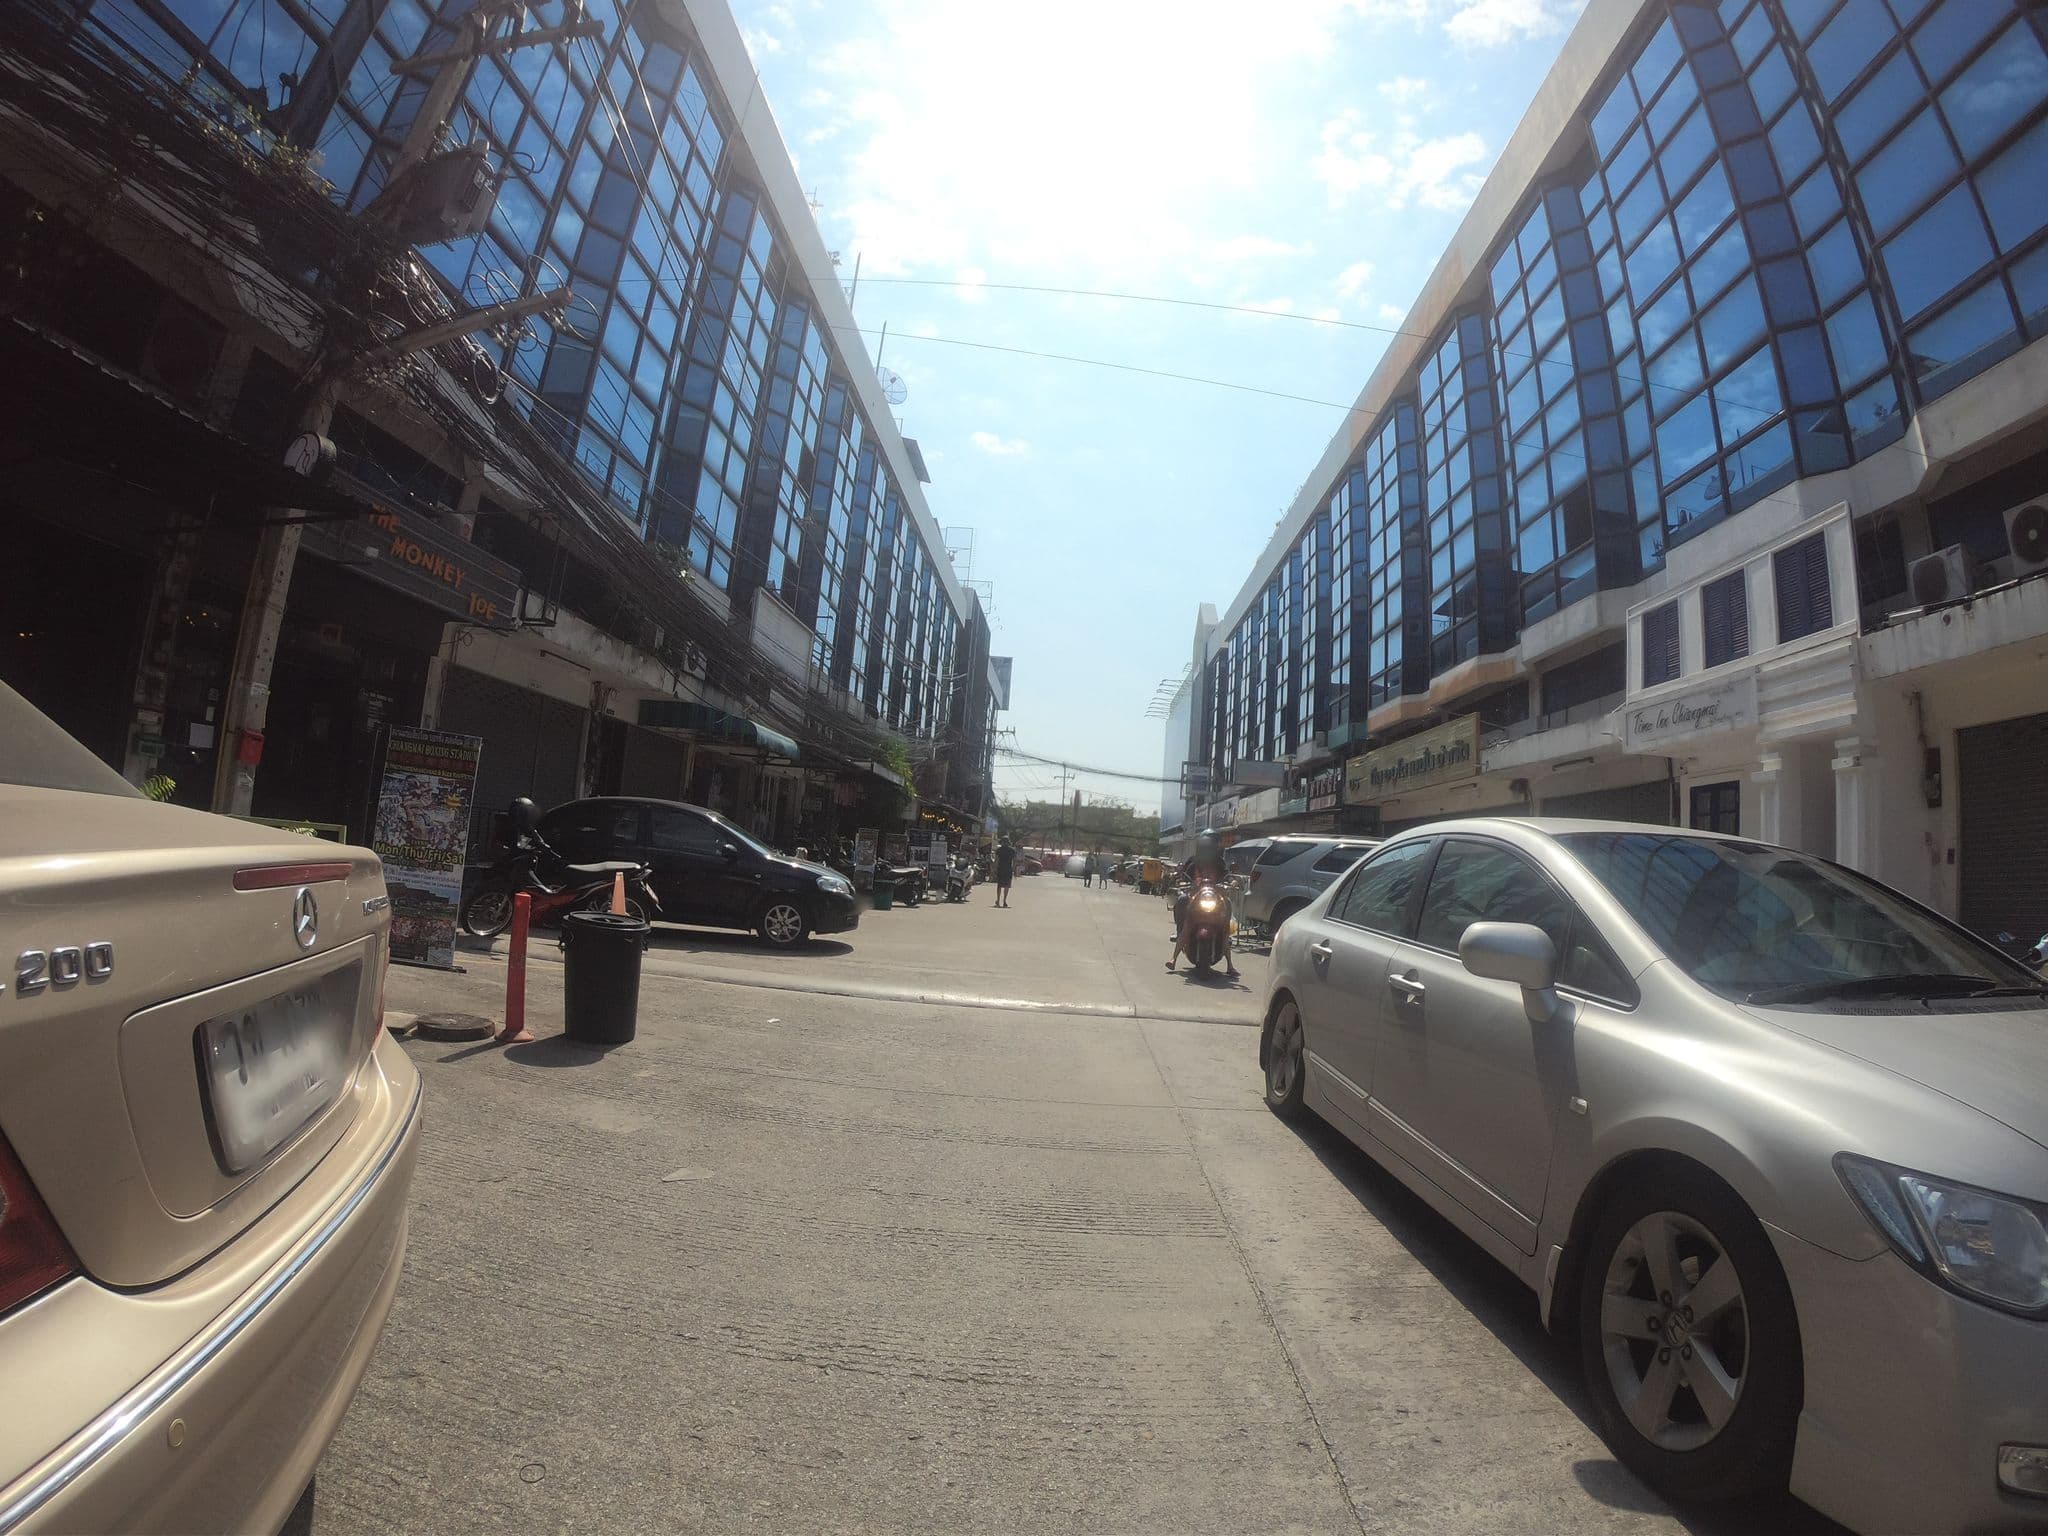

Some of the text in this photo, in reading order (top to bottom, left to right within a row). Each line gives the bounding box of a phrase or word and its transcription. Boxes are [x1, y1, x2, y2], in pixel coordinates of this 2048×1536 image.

[390, 536, 466, 591] MONKEY
[468, 591, 498, 621] TOE
[1634, 711, 1654, 734] Time
[374, 842, 464, 864] Mon/Thu/Fri/Sat
[15, 941, 114, 993] 200
